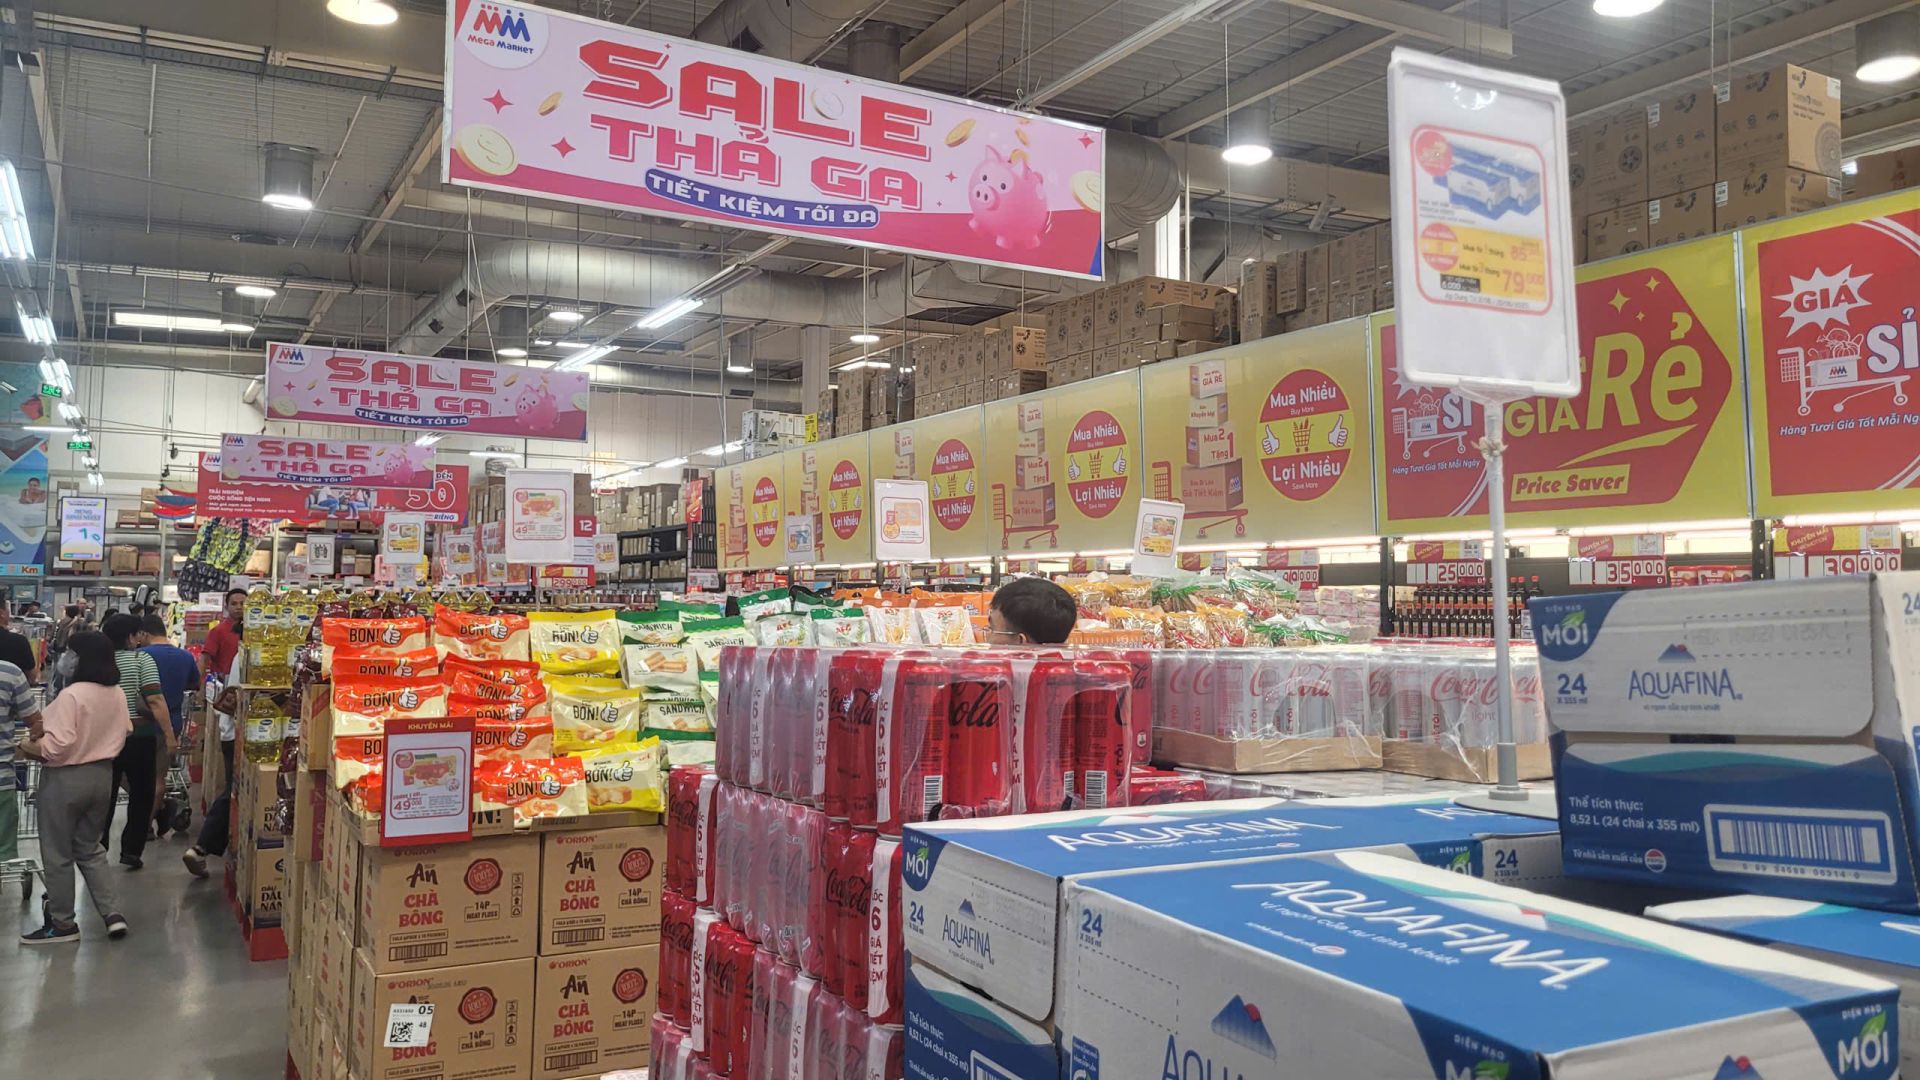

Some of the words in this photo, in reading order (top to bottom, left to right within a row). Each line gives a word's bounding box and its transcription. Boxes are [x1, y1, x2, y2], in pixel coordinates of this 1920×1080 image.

[579, 39, 933, 162] SALE
[590, 113, 782, 187] THẢ
[810, 156, 923, 211] GA
[649, 172, 711, 203] TIẾT
[719, 194, 786, 219] KIỆM
[795, 203, 835, 224] TỐI
[843, 210, 877, 224] ĐA
[1502, 269, 1526, 295] 79
[1793, 279, 1858, 313] GIÁ
[1865, 305, 1920, 375] SỈ
[325, 356, 498, 394] SALE
[1586, 311, 1704, 430] Rẻ
[330, 385, 421, 412] THẢ
[434, 395, 492, 418] GA
[1270, 386, 1297, 409] Mua
[1299, 383, 1337, 403] Nhiều
[356, 408, 384, 422] TIẾT
[389, 414, 423, 426] KIỆM
[425, 415, 447, 426] TỐI
[1780, 424, 1807, 437] Hàng
[1810, 420, 1835, 433] Tươi
[1837, 417, 1855, 430] Giá
[1858, 415, 1875, 428] Tốt
[1878, 411, 1900, 426] Mỗi
[1903, 413, 1920, 427] Ng
[1073, 425, 1091, 442] Mua
[1093, 423, 1119, 438] Nhiều
[1204, 433, 1218, 443] Mua
[1218, 428, 1225, 440] 2
[257, 440, 372, 461] SALE
[1227, 432, 1234, 458] 1
[935, 452, 949, 466] Mua
[950, 448, 969, 462] Nhiều
[1392, 465, 1409, 475] Hàng
[1409, 463, 1424, 473] Tươi
[1425, 462, 1437, 472] Giá
[1437, 460, 1448, 470] Tốt
[1448, 459, 1462, 469] Mỗi
[1462, 458, 1482, 471] Ngày
[260, 458, 321, 475] THẢ
[329, 463, 368, 476] GA
[1272, 464, 1297, 486] Lợi
[1299, 459, 1341, 478] Nhiều
[278, 472, 297, 481] TIẾT
[299, 475, 322, 484] KIỆM
[832, 474, 842, 483] Mua
[1514, 474, 1563, 496] Price
[1565, 472, 1626, 494] Saver
[1076, 486, 1093, 503] Lợi
[1094, 484, 1122, 499] Nhiều
[937, 505, 950, 519] Lợi
[950, 500, 972, 515] Nhiều
[578, 520, 593, 532] 12
[21, 565, 39, 575] Km
[349, 628, 380, 643] BON!
[553, 629, 580, 643] BON!
[477, 683, 506, 700] BON!
[1557, 672, 1588, 695] 24
[1628, 668, 1736, 701] AQUAFINA
[363, 692, 397, 708] BON!
[659, 701, 706, 717] SANDWICH
[573, 704, 599, 721] BON!
[752, 701, 759, 719] 6
[816, 702, 824, 722] 6
[408, 721, 438, 731] KHUYẾN
[878, 717, 885, 739] 6
[475, 731, 506, 745] BON!
[585, 768, 613, 783] BON!
[507, 781, 538, 797] BON!
[1569, 795, 1591, 808] Thể
[1592, 798, 1613, 810] tích
[1614, 799, 1644, 813] thực:
[1570, 814, 1591, 827] 8,52
[1593, 816, 1600, 826] L
[1602, 815, 1620, 830] (24
[1622, 817, 1645, 829] chai
[1647, 819, 1655, 830] x
[1656, 819, 1678, 831] 355
[1680, 820, 1700, 834] ml)
[565, 835, 595, 844] ORION
[1047, 816, 1344, 852] AQUAFINA
[1494, 849, 1520, 869] 24
[564, 876, 596, 893] CHÀ
[628, 888, 642, 896] 14P
[404, 889, 439, 908] CHÀ
[474, 900, 491, 910] 14P
[560, 894, 600, 912] BÔNG
[399, 909, 444, 929] BÔNG
[871, 909, 882, 931] 6
[910, 900, 925, 926] 24
[1081, 908, 1103, 938] 24
[942, 914, 992, 965] AQUAFINA
[1231, 879, 1610, 989] AQUAFINA
[558, 958, 588, 968] ORION
[398, 978, 430, 989] ORION
[418, 1004, 434, 1015] 05
[558, 999, 590, 1019] CHÀ
[622, 1009, 637, 1018] 14P
[1841, 1007, 1863, 1020] DIỆN
[1864, 1003, 1883, 1016] MẠO
[469, 1030, 484, 1040] 14P
[553, 1019, 594, 1038] BÔNG
[908, 1010, 919, 1025] Thể
[919, 1017, 930, 1031] tích
[930, 1023, 945, 1041] thực:
[908, 1026, 919, 1041] 8,52
[923, 1037, 933, 1050] (24
[1453, 1033, 1479, 1051] DIỆN
[1481, 1044, 1506, 1062] MẠO
